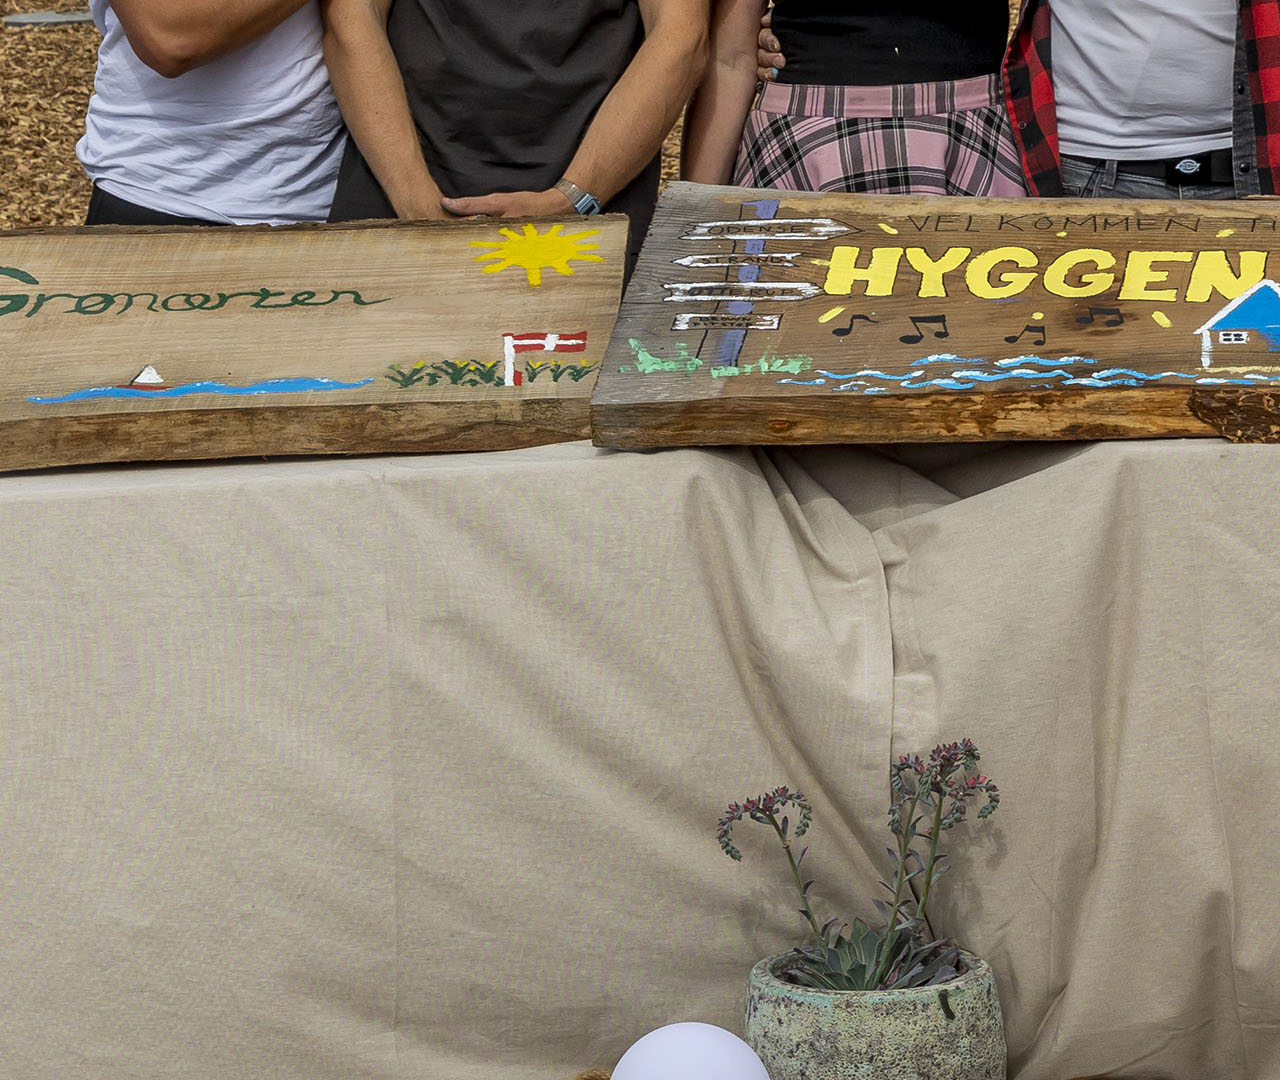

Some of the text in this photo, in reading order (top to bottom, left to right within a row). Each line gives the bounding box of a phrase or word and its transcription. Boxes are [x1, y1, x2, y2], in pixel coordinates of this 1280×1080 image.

[708, 225, 806, 236] ODENSE
[906, 215, 1201, 233] VELKOMMEN
[823, 245, 1269, 303] HYGGEN
